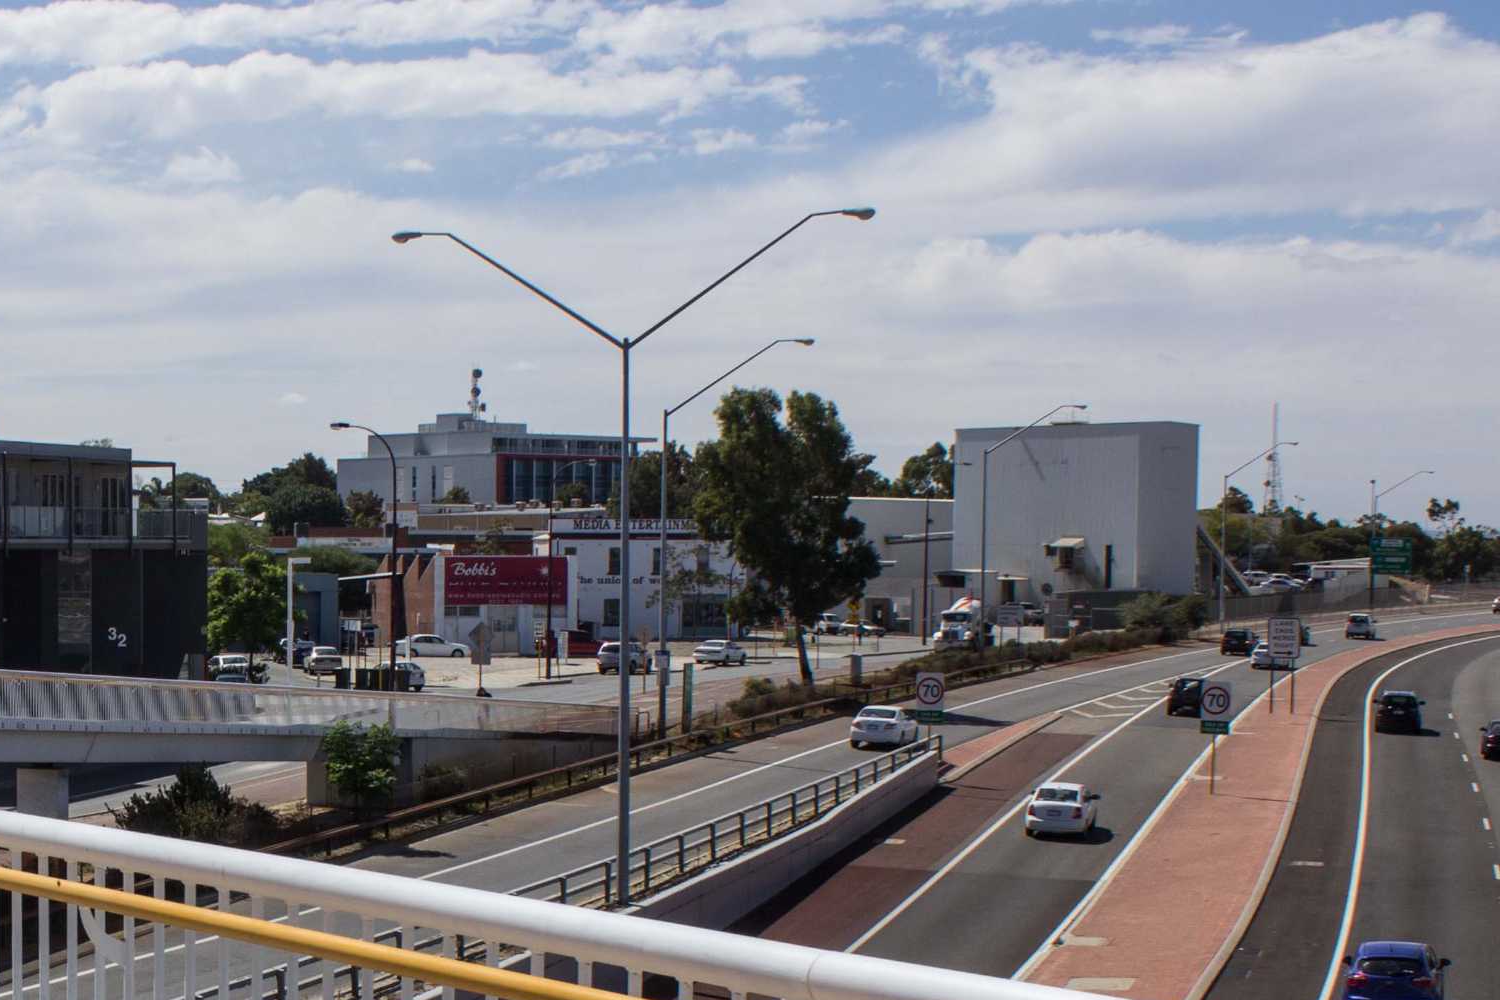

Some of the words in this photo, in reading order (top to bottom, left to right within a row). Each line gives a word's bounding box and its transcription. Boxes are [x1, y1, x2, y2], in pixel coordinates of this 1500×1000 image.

[573, 519, 611, 530] MEDIA
[450, 561, 498, 576] Bobbi's
[633, 576, 645, 584] of
[108, 627, 127, 647] 32
[922, 684, 940, 697] 70
[1207, 694, 1225, 707] 70
